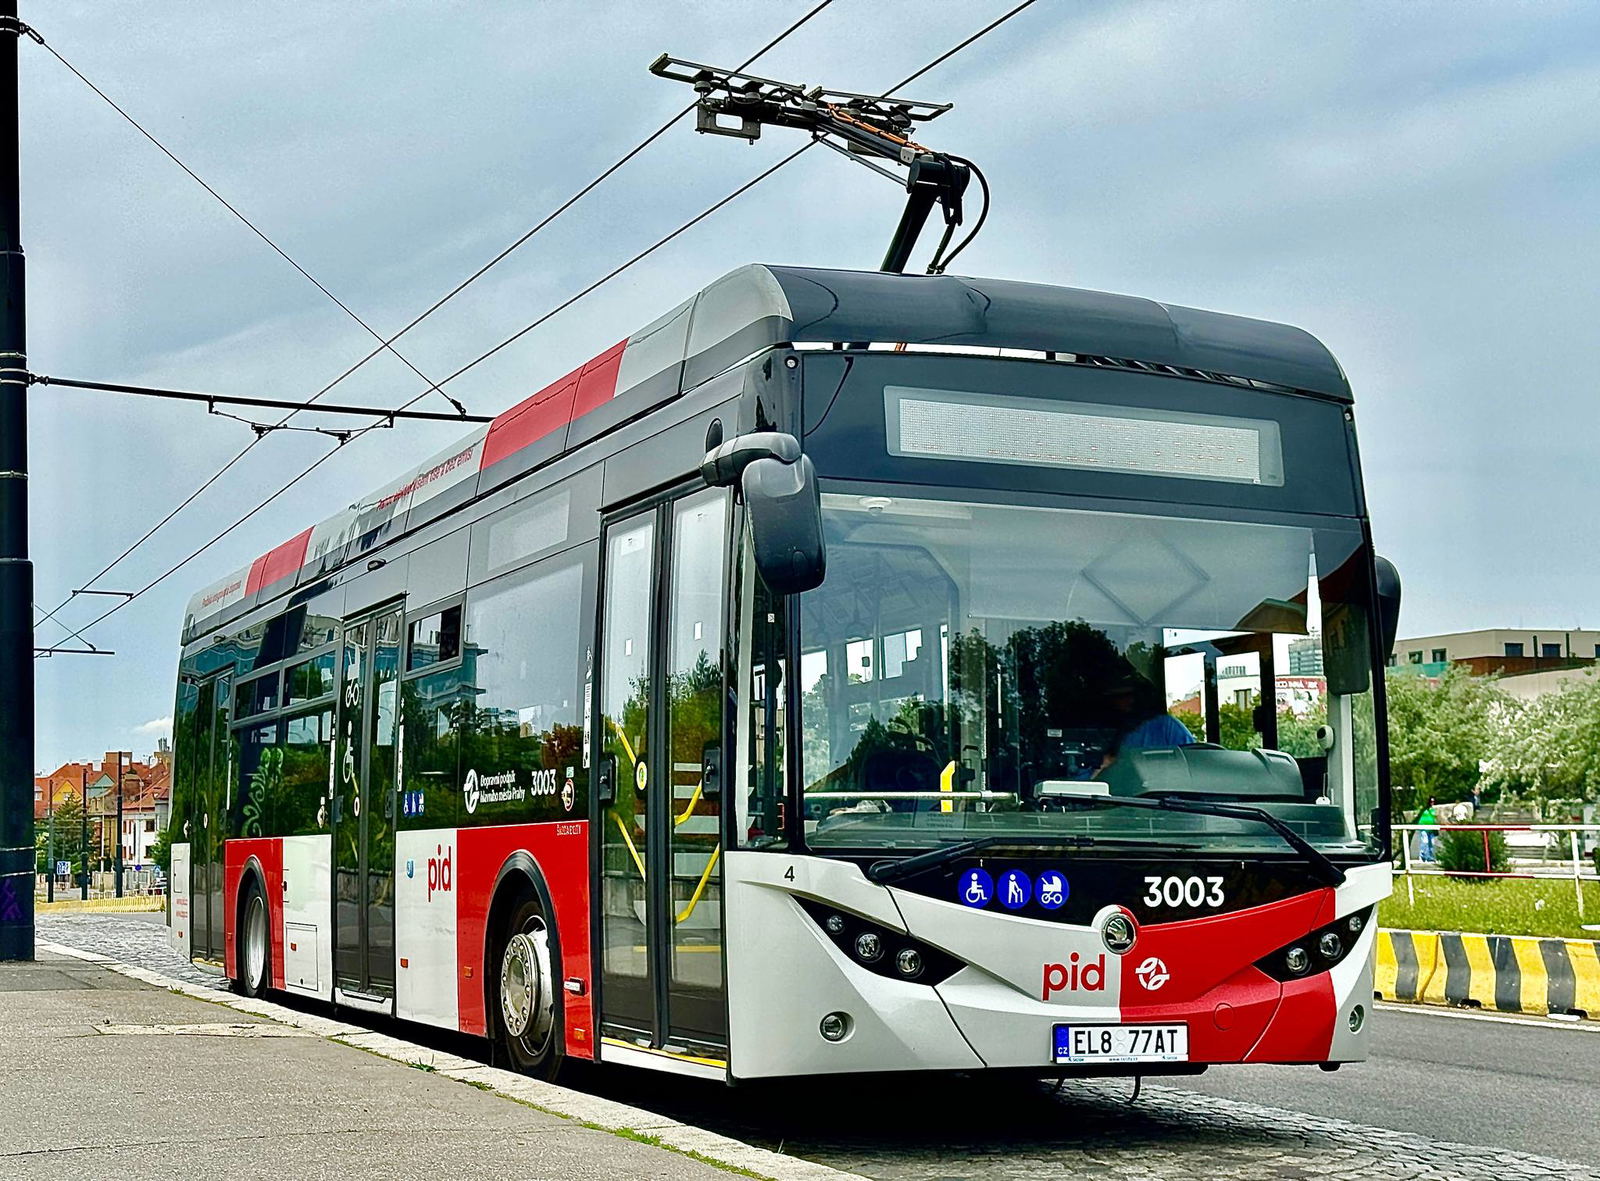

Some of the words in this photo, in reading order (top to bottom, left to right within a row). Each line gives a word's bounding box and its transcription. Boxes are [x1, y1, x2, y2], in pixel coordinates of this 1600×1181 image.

[500, 769, 516, 787] podnik
[530, 768, 557, 796] 3003
[511, 785, 526, 802] Prahy
[427, 843, 452, 903] pid
[784, 865, 796, 882] 4
[1143, 875, 1225, 908] 3003
[1042, 952, 1106, 1002] pid
[1057, 1046, 1068, 1055] CZ
[1074, 1030, 1112, 1054] EL8
[1128, 1029, 1178, 1053] 77AT
